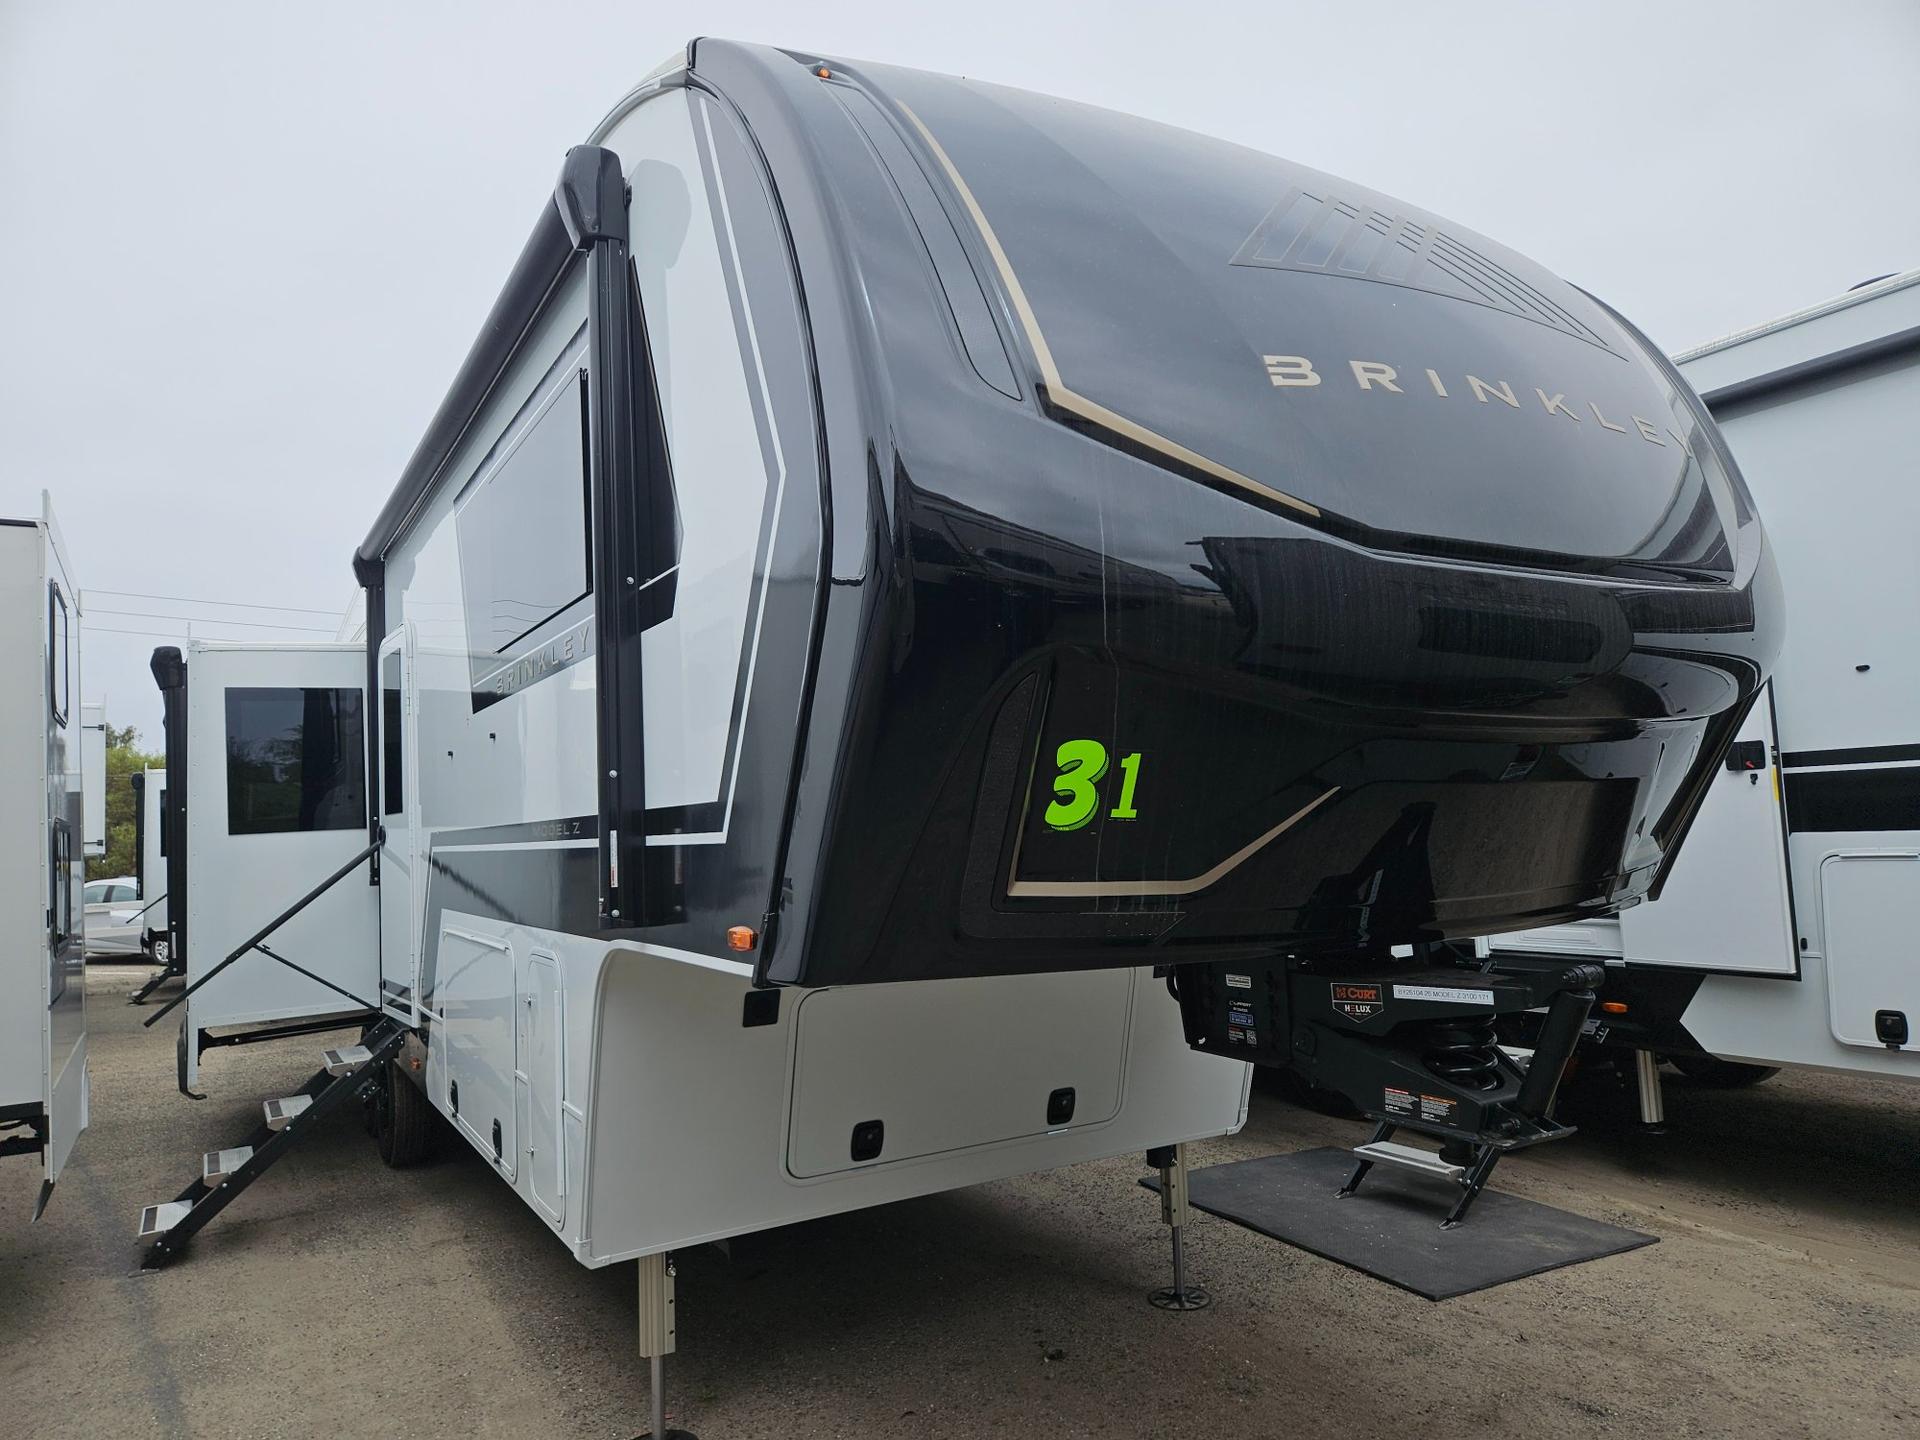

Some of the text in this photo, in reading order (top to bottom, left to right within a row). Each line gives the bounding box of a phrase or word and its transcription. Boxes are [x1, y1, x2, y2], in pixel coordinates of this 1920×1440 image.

[496, 625, 589, 694] BRINKLEY
[1044, 738, 1142, 832] 31
[573, 822, 580, 834] Z
[1347, 987, 1377, 1000] CURT
